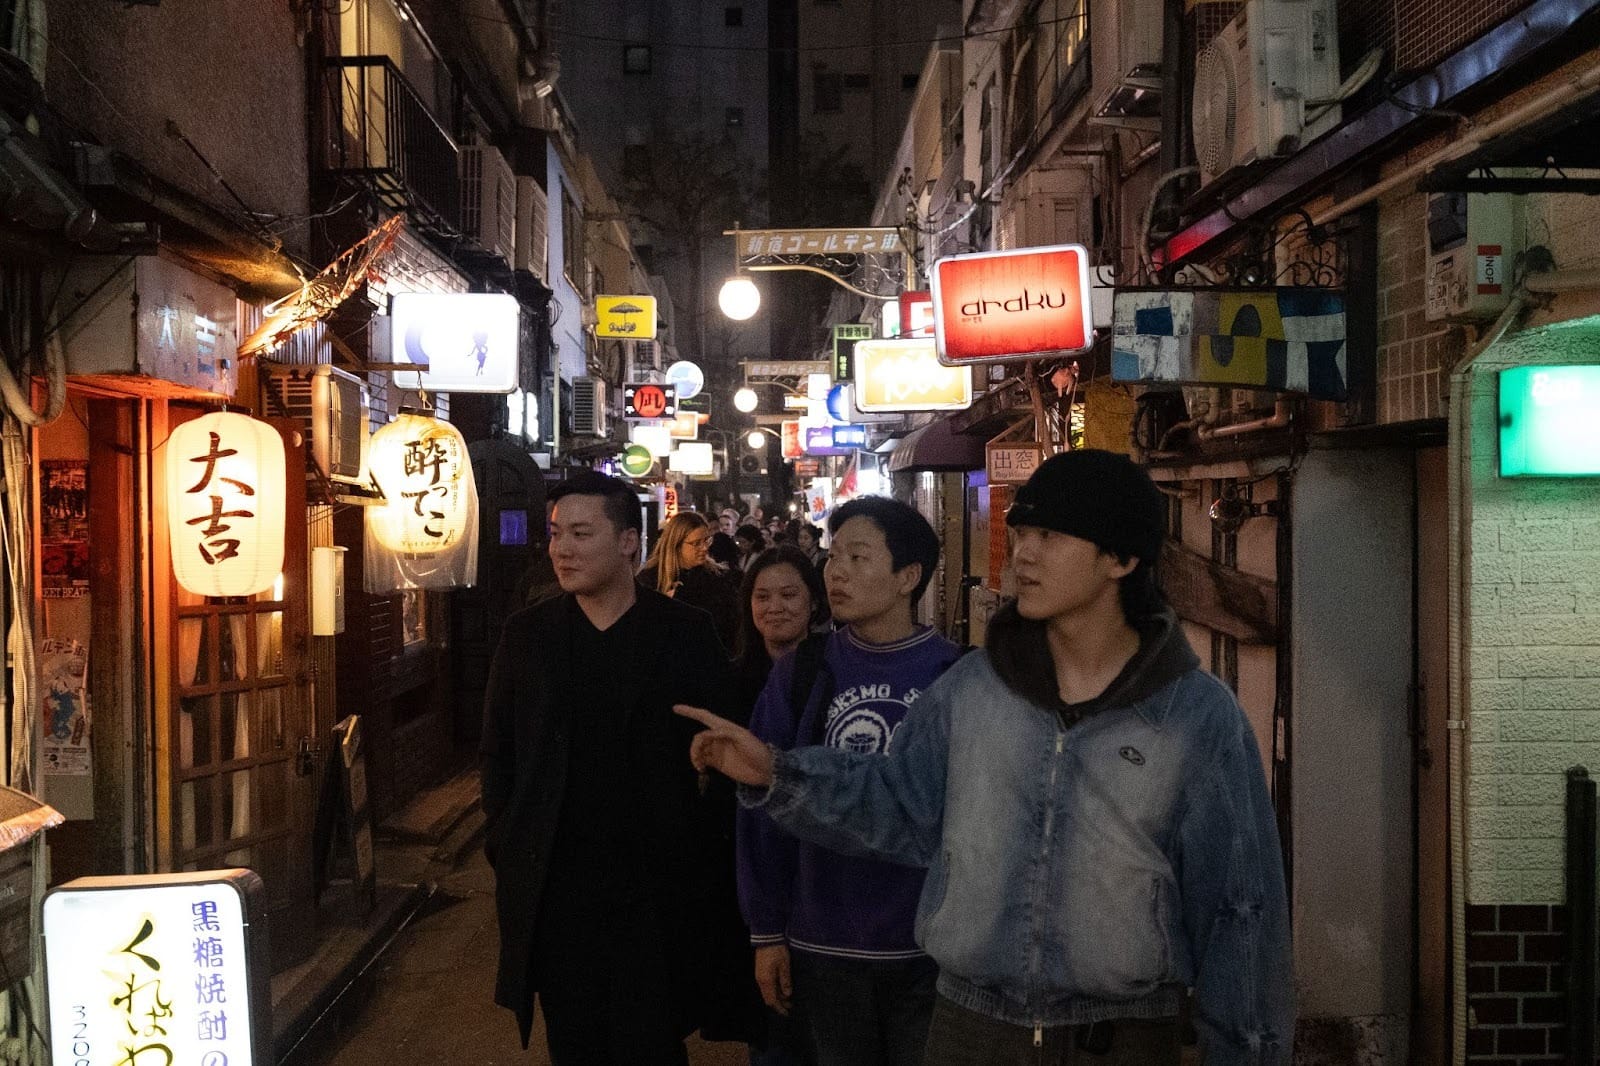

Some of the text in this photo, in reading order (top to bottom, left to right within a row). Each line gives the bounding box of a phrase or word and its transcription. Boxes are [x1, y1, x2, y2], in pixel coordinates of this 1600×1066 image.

[747, 234, 900, 253] 新宿ゴールデン街
[961, 287, 1066, 317] araku
[994, 450, 1035, 470] 出窓
[185, 431, 255, 565] 大吉
[401, 437, 448, 538] 酔ってこ
